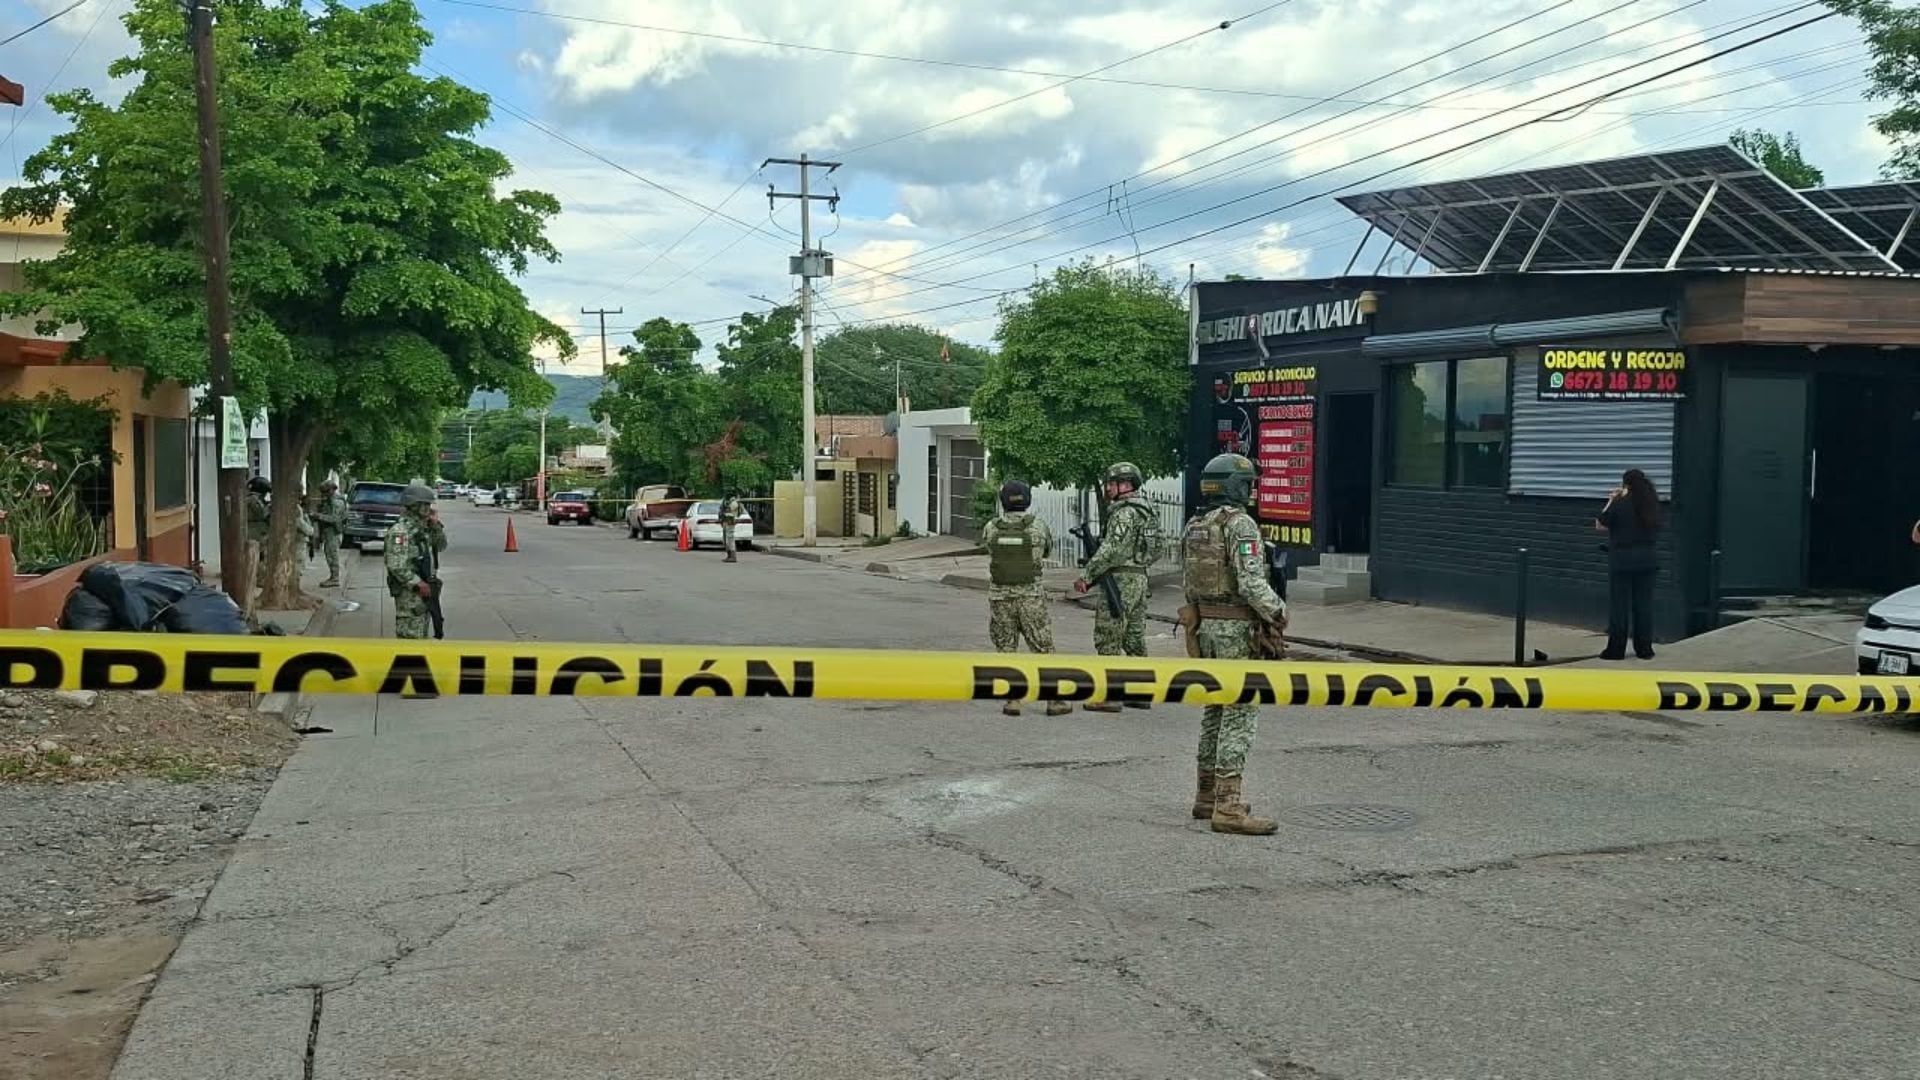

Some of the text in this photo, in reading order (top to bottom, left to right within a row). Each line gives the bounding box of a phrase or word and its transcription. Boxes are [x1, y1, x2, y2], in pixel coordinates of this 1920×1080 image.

[1544, 350, 1686, 369] ORDENE Y RECOJA
[1564, 371, 1603, 390] 6673
[1633, 372, 1652, 390] 19
[1656, 372, 1677, 390] 10
